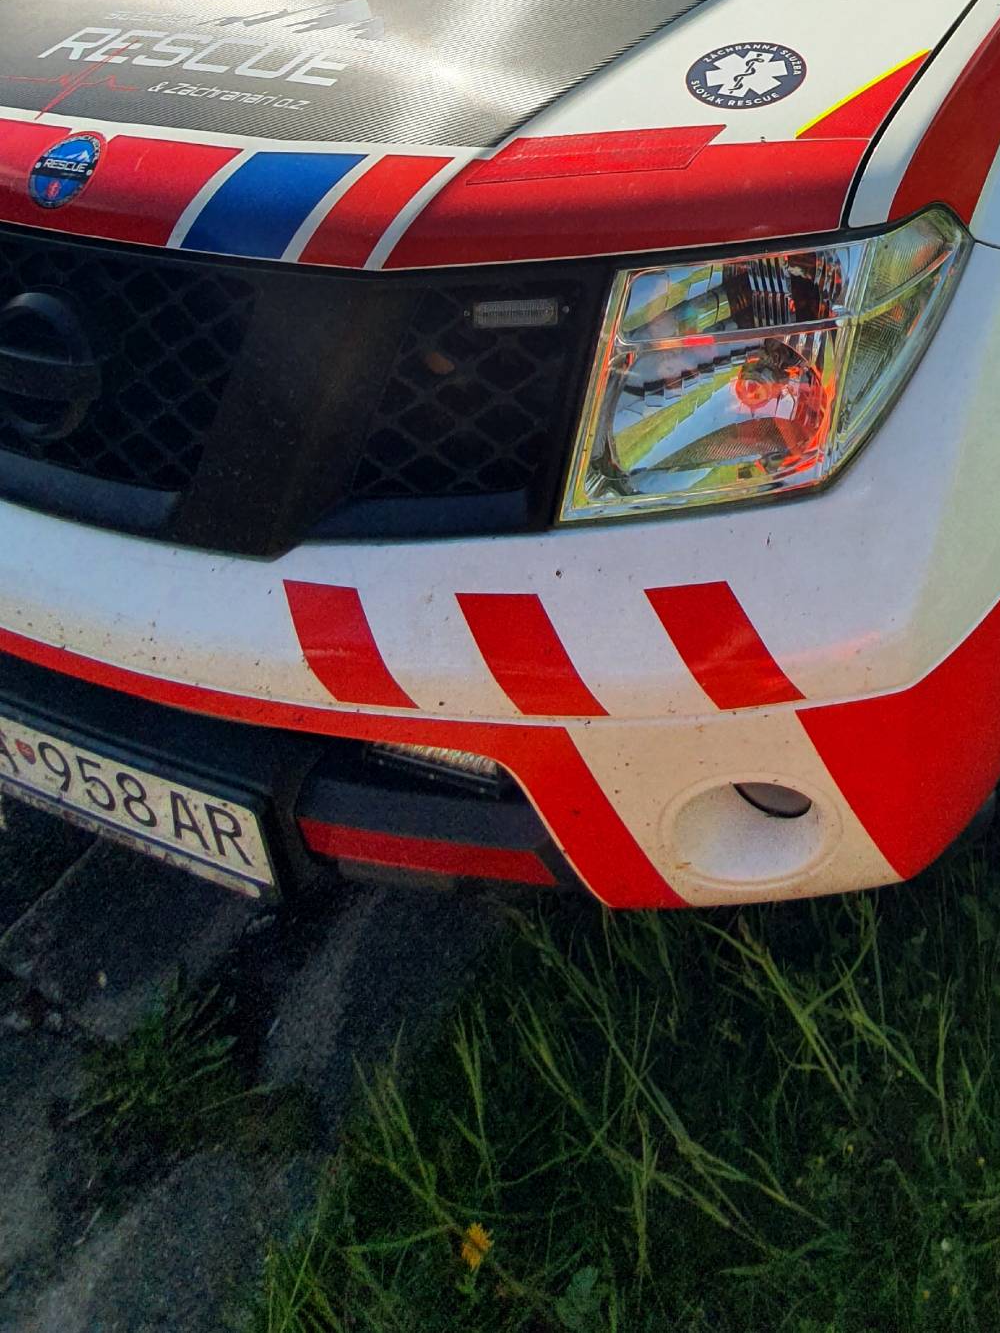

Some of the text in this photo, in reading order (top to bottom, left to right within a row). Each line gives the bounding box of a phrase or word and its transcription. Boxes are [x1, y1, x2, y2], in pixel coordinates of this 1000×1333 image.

[38, 27, 368, 86] RESCUE
[147, 81, 169, 92] &
[690, 79, 780, 107] SLOVAK RESCUE
[43, 158, 88, 173] RESCUE
